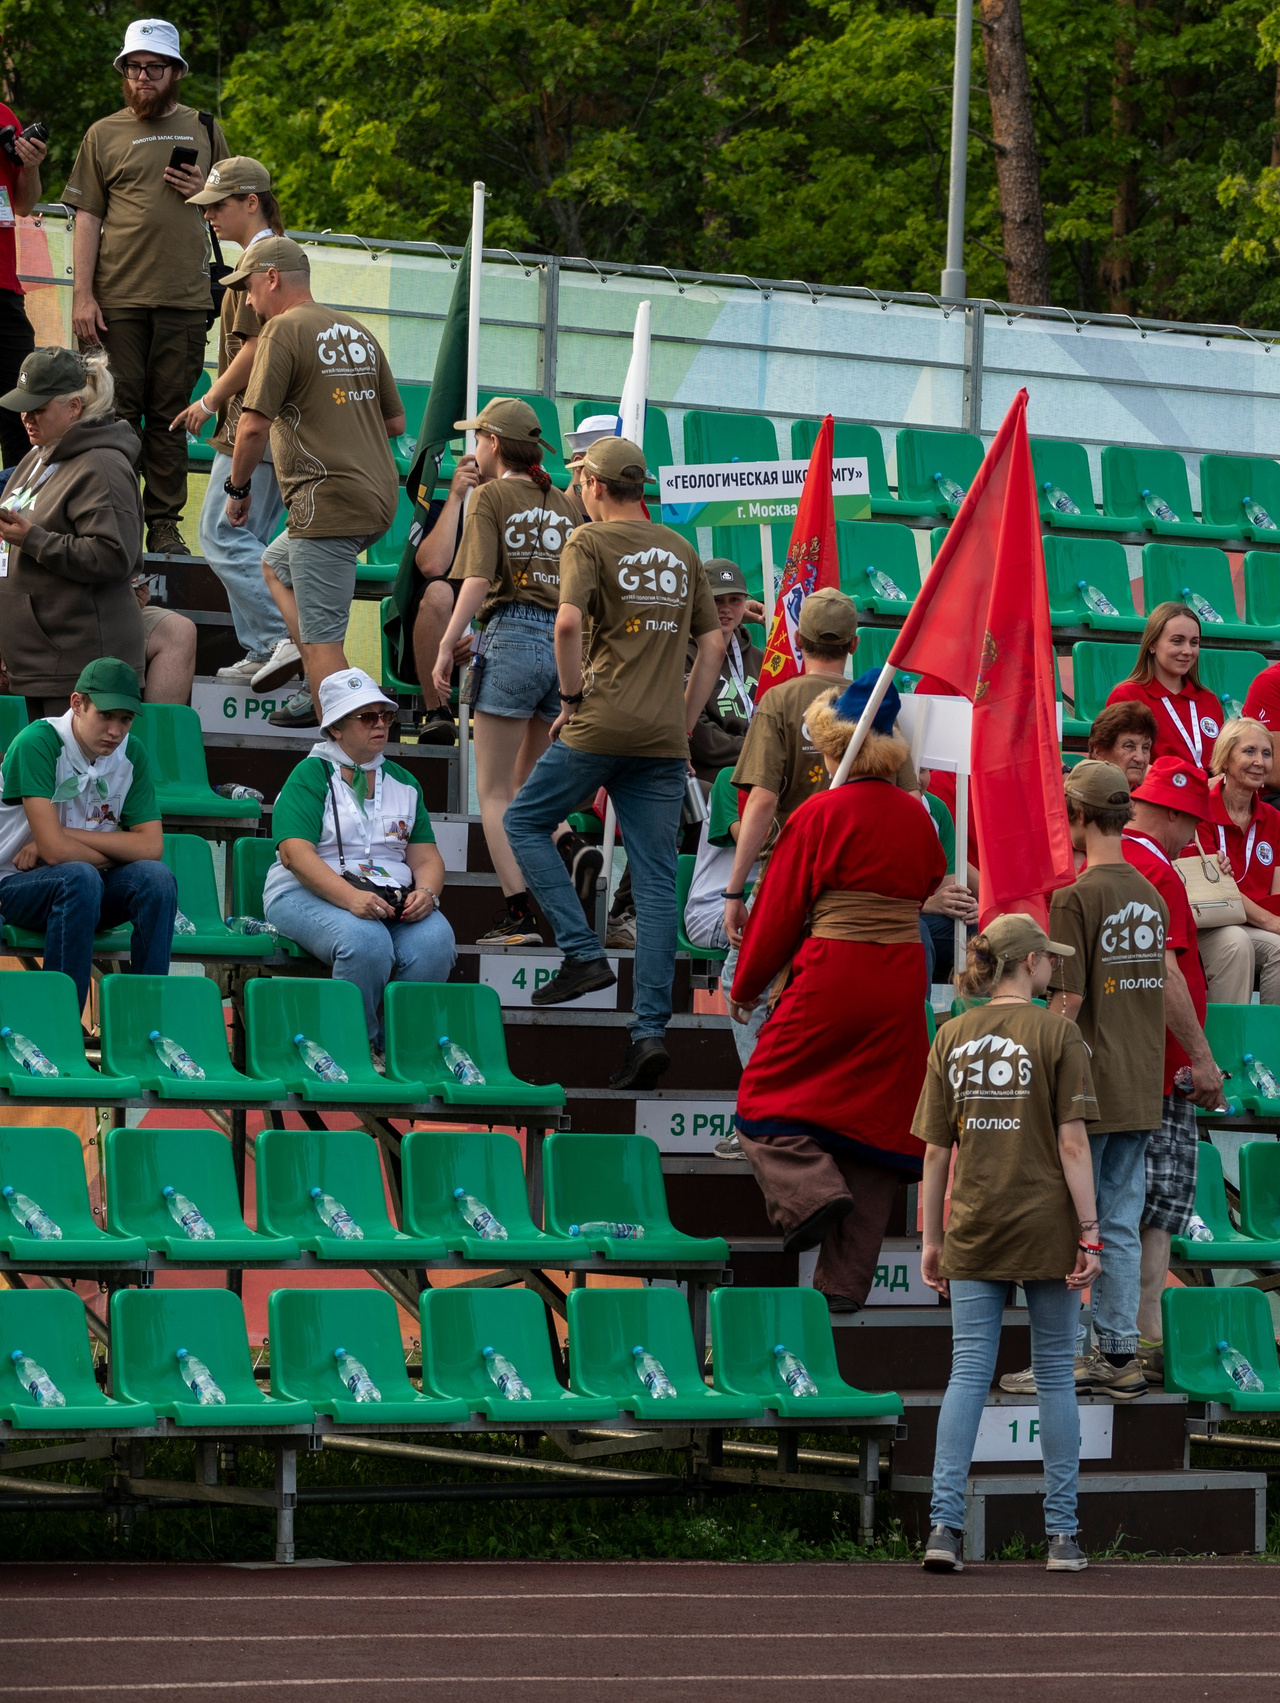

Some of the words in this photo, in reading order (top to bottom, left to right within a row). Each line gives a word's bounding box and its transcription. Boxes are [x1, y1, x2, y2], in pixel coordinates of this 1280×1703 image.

[132, 135, 157, 145] ЗОЛОТОЙ
[348, 389, 376, 401] ПОЛЮ
[666, 470, 779, 490] «ГЕОЛОГИЧЕСКАЯ
[832, 467, 863, 482] МГУ»
[737, 507, 746, 519] г.
[749, 502, 798, 518] Москва
[533, 571, 560, 585] ПОЛ
[223, 697, 237, 719] 6
[244, 698, 289, 720] РЯ
[717, 700, 748, 720] FIL
[1101, 924, 1164, 953] GEOS
[512, 968, 527, 990] 4
[948, 1058, 1033, 1090] GEOS
[670, 1113, 685, 1137] 3
[966, 1117, 1021, 1130] ПОЛЮС
[873, 1265, 910, 1293] ЯД
[1008, 1419, 1018, 1443] 1
